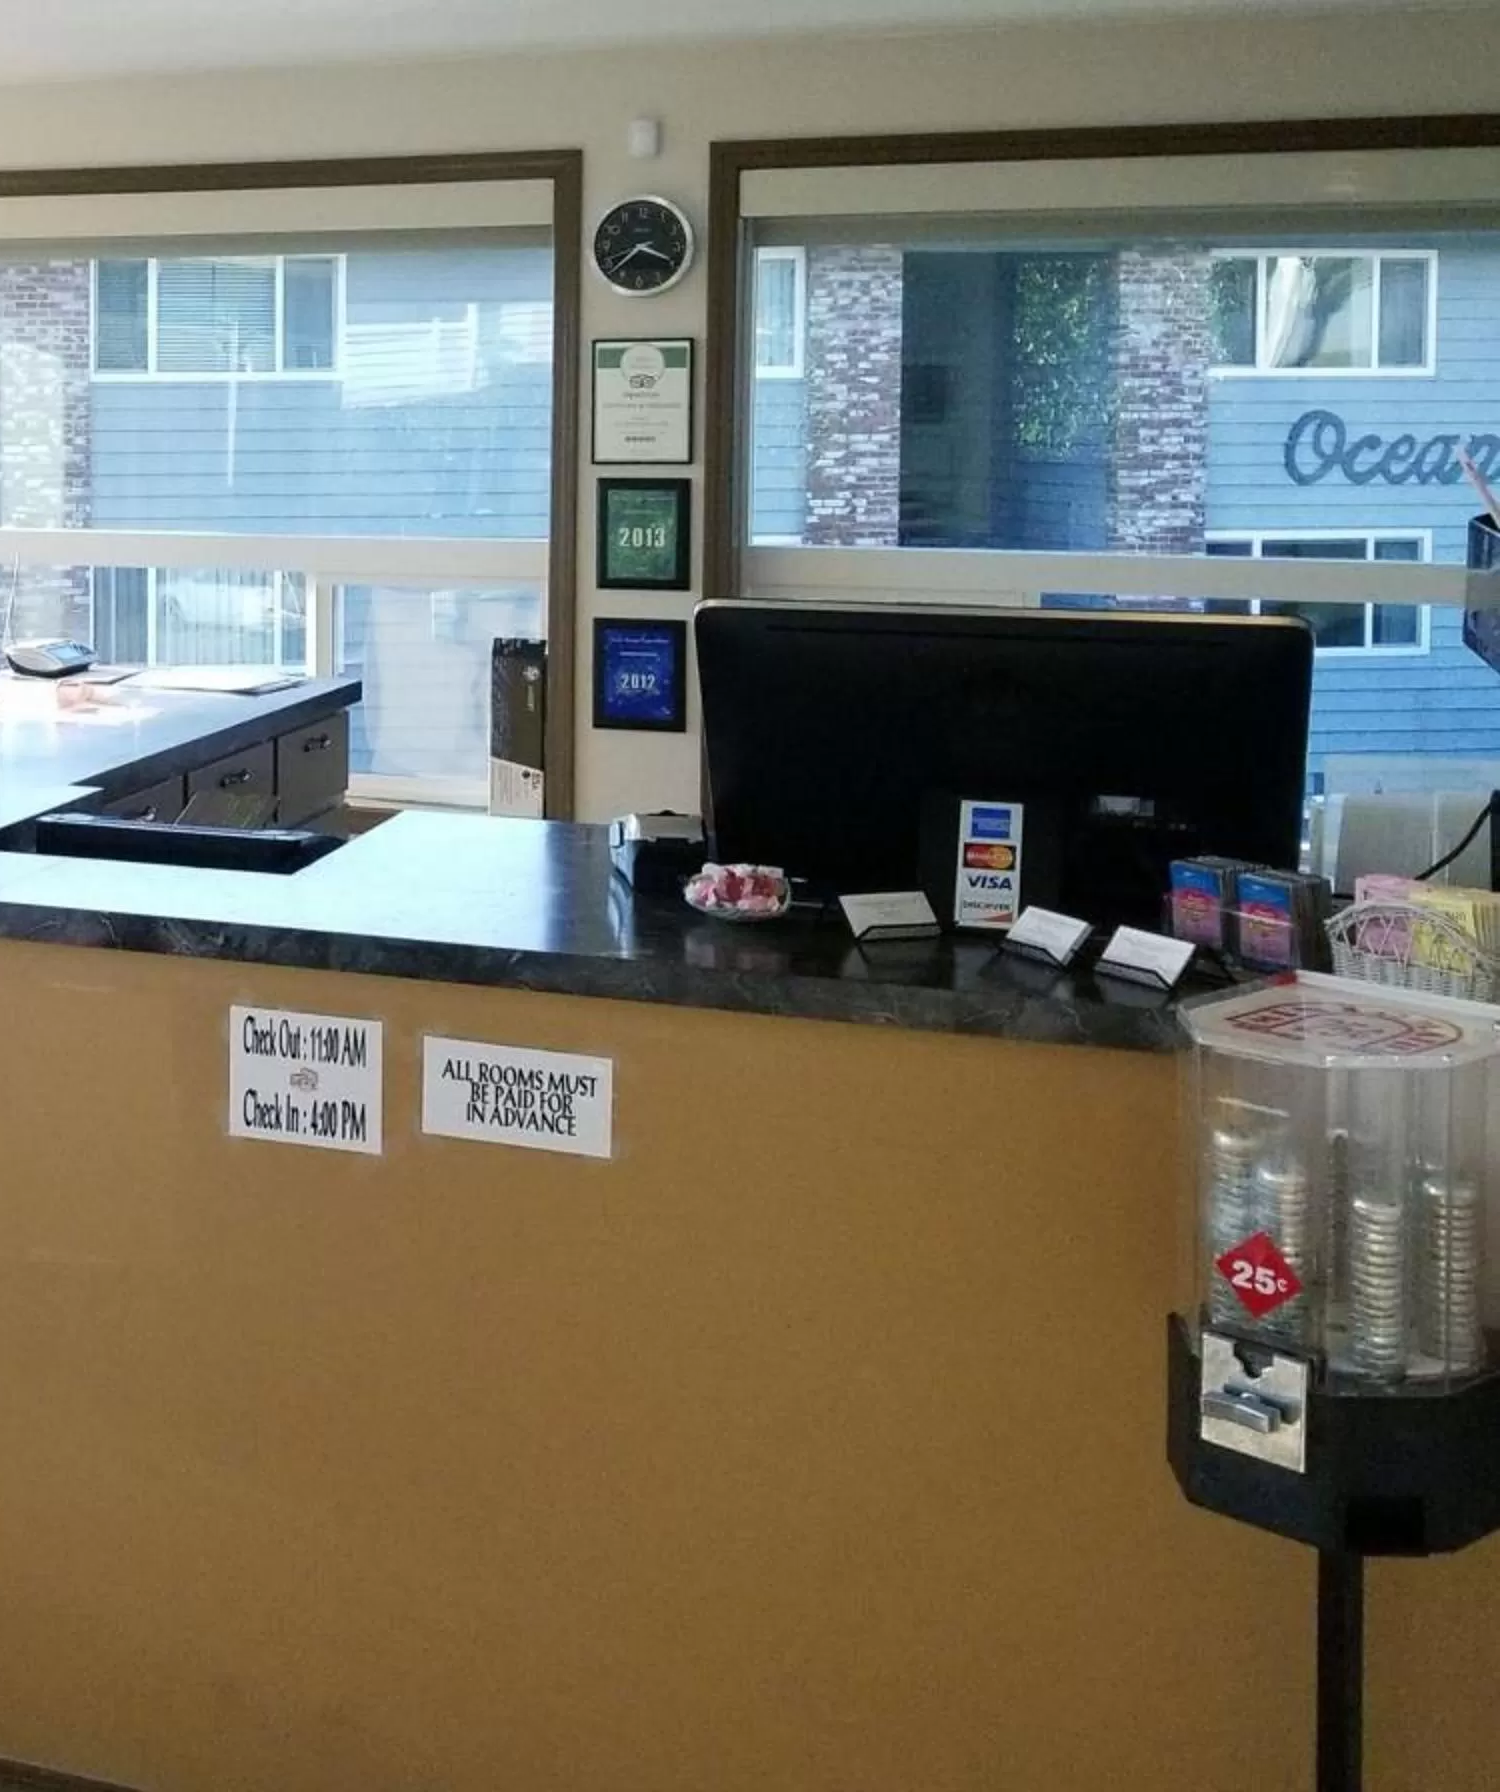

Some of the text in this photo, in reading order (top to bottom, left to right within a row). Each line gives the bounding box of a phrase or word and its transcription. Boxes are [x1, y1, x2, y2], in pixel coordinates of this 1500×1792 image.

[1284, 409, 1500, 486] Ocean
[618, 526, 666, 548] 2013
[620, 672, 656, 690] 2012
[967, 875, 1013, 891] VISA
[243, 1015, 277, 1057] Check
[279, 1019, 301, 1060] Out
[310, 1026, 339, 1064] 11:00
[340, 1025, 367, 1069] AM
[441, 1057, 598, 1098] ALL ROOMS MUST
[243, 1088, 282, 1132] Check
[285, 1093, 299, 1133] In
[310, 1099, 338, 1139] 4:00
[341, 1100, 367, 1143] PM
[470, 1080, 573, 1115] BE PAID FOR
[465, 1101, 577, 1137] IN ADVANCE
